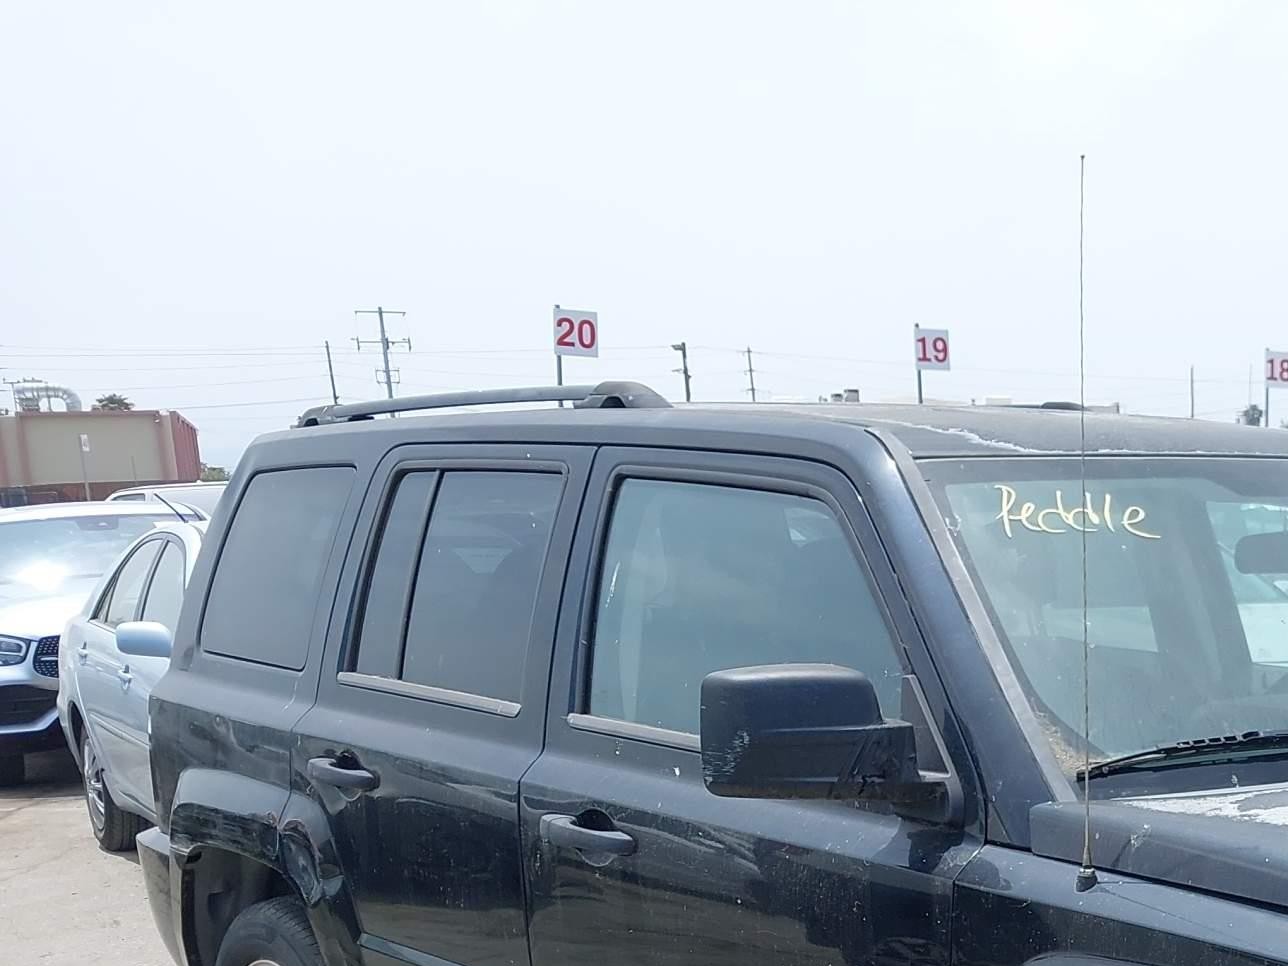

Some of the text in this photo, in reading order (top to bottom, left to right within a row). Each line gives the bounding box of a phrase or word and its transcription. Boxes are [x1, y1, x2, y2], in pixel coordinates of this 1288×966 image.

[556, 317, 596, 349] 20
[916, 336, 948, 363] 19
[994, 484, 1162, 539] Peddle
